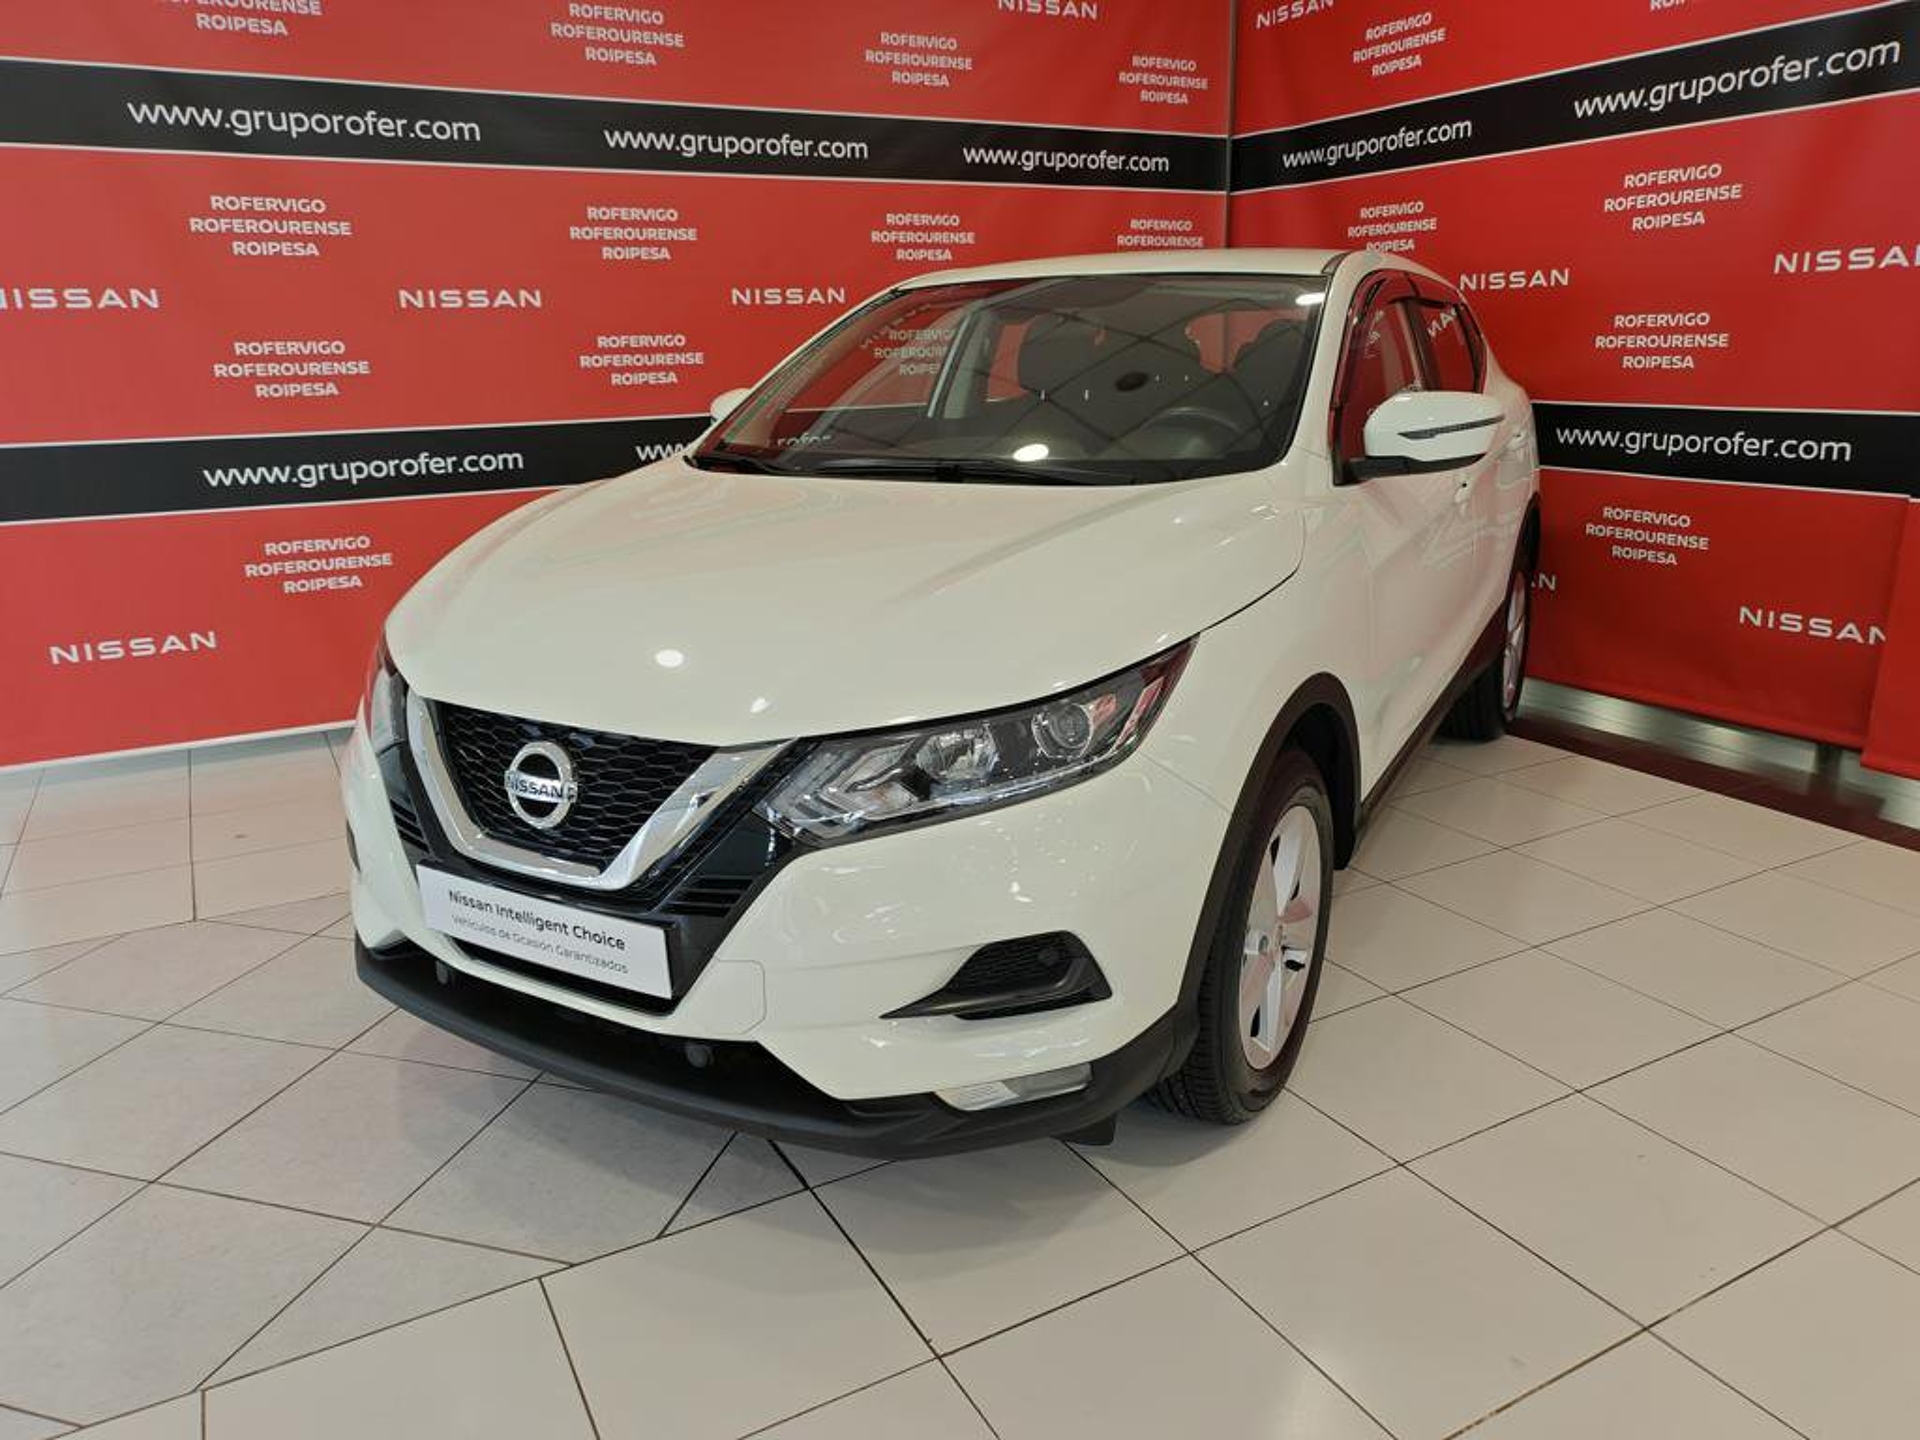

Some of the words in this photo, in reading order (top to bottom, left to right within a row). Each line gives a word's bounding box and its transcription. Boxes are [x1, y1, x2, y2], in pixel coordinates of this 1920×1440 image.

[569, 3, 664, 24] ROFERVIGO
[998, 0, 1098, 20] NISSAN
[195, 12, 288, 36] ROIPESA
[1365, 12, 1432, 41] ROFERVIGO
[551, 22, 685, 47] ROFEROURENSE
[881, 32, 957, 50] ROFERVIGO
[1353, 28, 1446, 64] ROFEROURENSE
[585, 47, 657, 65] ROIPESA
[866, 49, 972, 70] ROFEROURENSE
[1132, 55, 1196, 72] ROFERVIGO
[1372, 54, 1422, 76] ROIPESA
[892, 70, 949, 87] ROIPESA
[1118, 71, 1208, 90] ROFEROURENSE
[1574, 40, 1901, 119] www.gruporofer.com
[1140, 89, 1189, 104] ROIPESA
[127, 102, 481, 142] www.gruporofer.com
[603, 129, 869, 161] www.gruporofer.com
[1281, 118, 1473, 169] www.gruporofer.com
[963, 146, 1170, 174] www.gruporofer.com
[1624, 163, 1722, 188] ROFERVIGO
[210, 195, 326, 214] ROFERVIGO
[1604, 183, 1742, 213] ROFEROURENSE
[587, 206, 679, 222] ROFERVIGO
[1360, 200, 1425, 219] ROFERVIGO
[189, 217, 352, 236] ROFEROURENSE
[886, 213, 960, 226] ROFERVIGO
[1130, 218, 1193, 232] ROFERVIGO
[1347, 217, 1438, 238] ROFEROURENSE
[1632, 210, 1706, 232] ROIPESA
[570, 226, 698, 242] ROFEROURENSE
[870, 229, 975, 245] ROFEROURENSE
[1117, 234, 1204, 247] ROFEROURENSE
[232, 241, 320, 257] ROIPESA
[602, 246, 671, 261] ROIPESA
[1366, 239, 1415, 251] ROIPESA
[896, 248, 953, 262] ROIPESA
[1773, 244, 1920, 275] NISSA
[1459, 268, 1570, 291] NISSAN
[399, 288, 543, 309] NISSAN
[731, 287, 846, 306] NISSAN
[1614, 312, 1711, 329] ROFERVIGO
[234, 340, 345, 356] ROFERVIGO
[597, 333, 686, 349] ROFERVIGO
[1595, 332, 1730, 350] ROFEROURENSE
[213, 359, 371, 378] ROFEROURENSE
[579, 352, 705, 369] ROFEROURENSE
[1622, 354, 1695, 370] ROIPESA
[610, 370, 678, 386] ROIPESA
[255, 382, 340, 398] ROIPESA
[1556, 427, 1852, 462] www.gruporofer.com
[203, 451, 525, 489] www.gruporofer.com
[1602, 507, 1691, 528] ROFERVIGO
[264, 536, 371, 556] ROFERVIGO
[1586, 523, 1710, 551] ROFEROURENSE
[1612, 545, 1678, 566] ROIPESA
[245, 553, 394, 578] ROFEROURENSE
[283, 575, 364, 594] ROIPESA
[49, 630, 218, 665] NISSAN
[508, 776, 563, 798] NISSAN
[449, 890, 494, 914] Nissan
[496, 905, 569, 936] Intelligent
[573, 925, 626, 950] Choice
